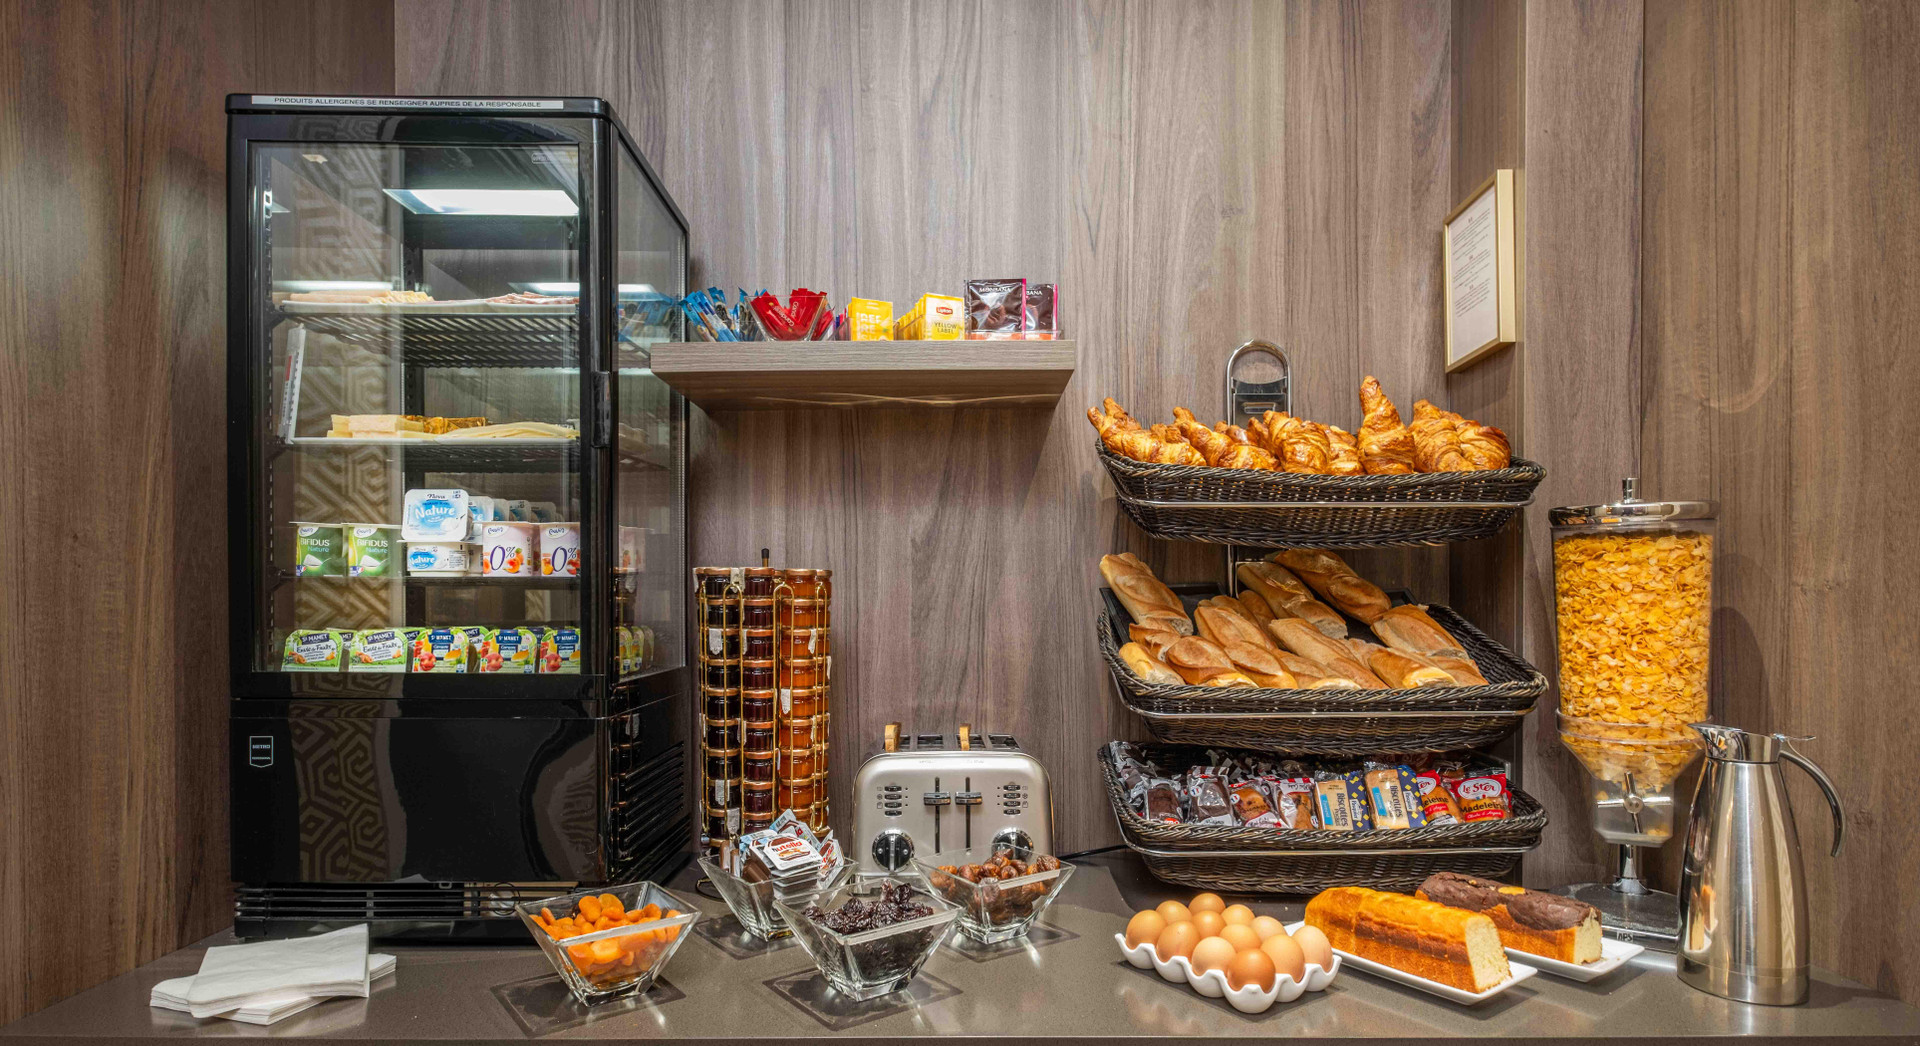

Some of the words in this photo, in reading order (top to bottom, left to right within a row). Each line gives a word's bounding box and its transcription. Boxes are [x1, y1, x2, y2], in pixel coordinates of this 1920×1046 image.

[937, 326, 954, 334] LABEL
[414, 505, 456, 519] Nature
[300, 538, 330, 547] BIFIDUS
[357, 539, 388, 547] BIFIDUS
[490, 545, 516, 571] 0%
[551, 546, 577, 572] 0%
[1462, 784, 1471, 794] le
[1390, 785, 1403, 818] Biscottes
[1424, 796, 1449, 806] eleine
[1336, 792, 1348, 827] Biscottes
[772, 841, 803, 852] nutella
